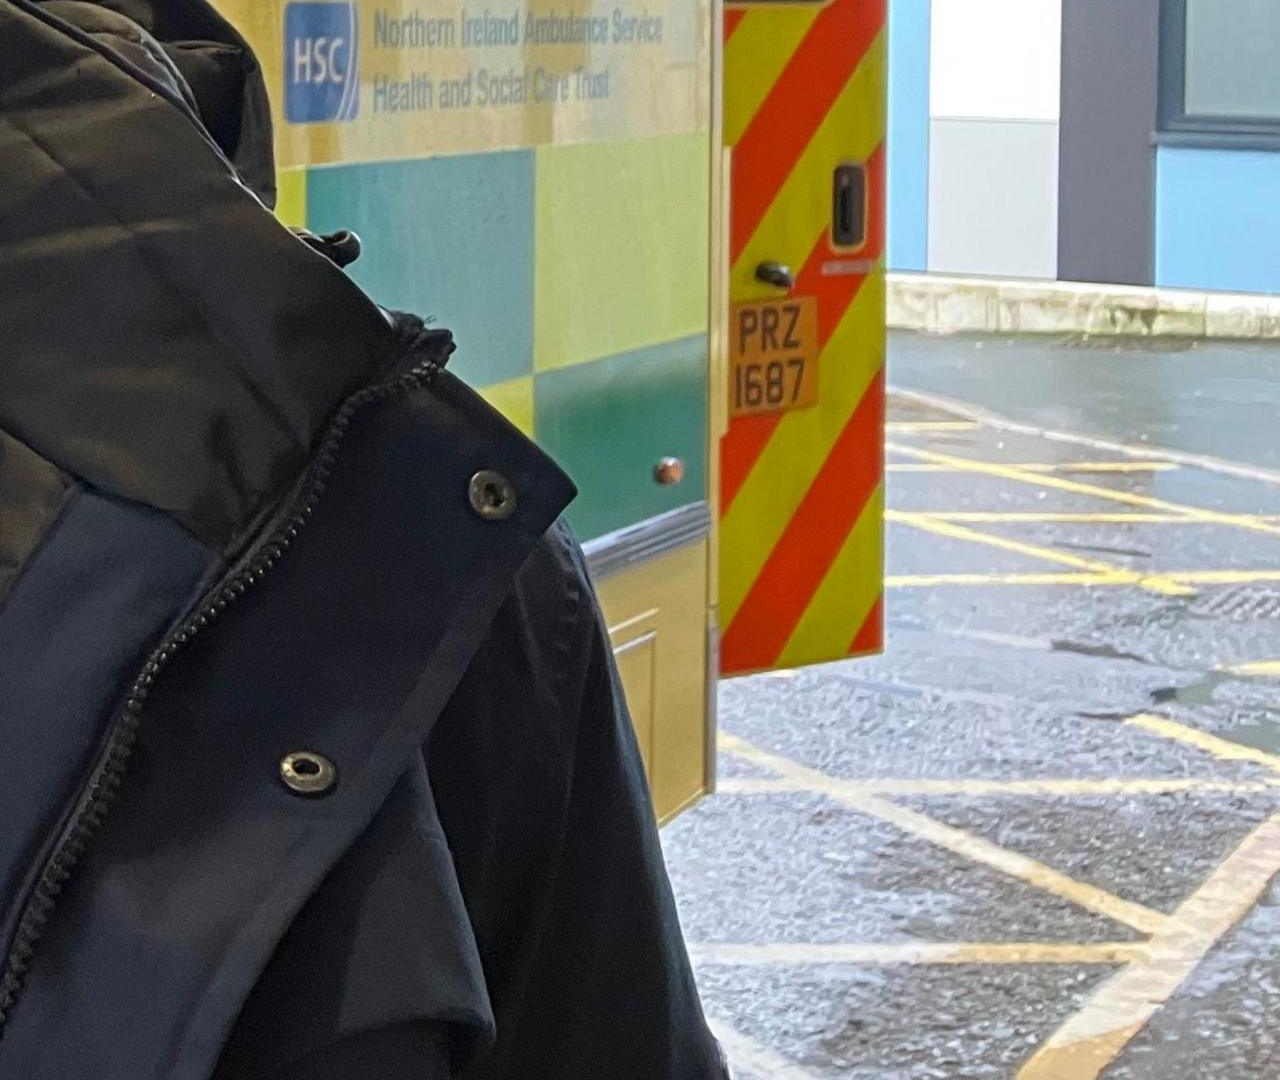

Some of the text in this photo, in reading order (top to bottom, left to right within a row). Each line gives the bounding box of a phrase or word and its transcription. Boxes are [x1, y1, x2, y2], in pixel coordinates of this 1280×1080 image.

[374, 7, 663, 49] Northern Ireland Ambulance Service
[293, 37, 344, 85] HSC
[373, 66, 610, 114] Health and Social Care Trust
[739, 306, 801, 356] PRZ
[735, 357, 805, 408] 1687
